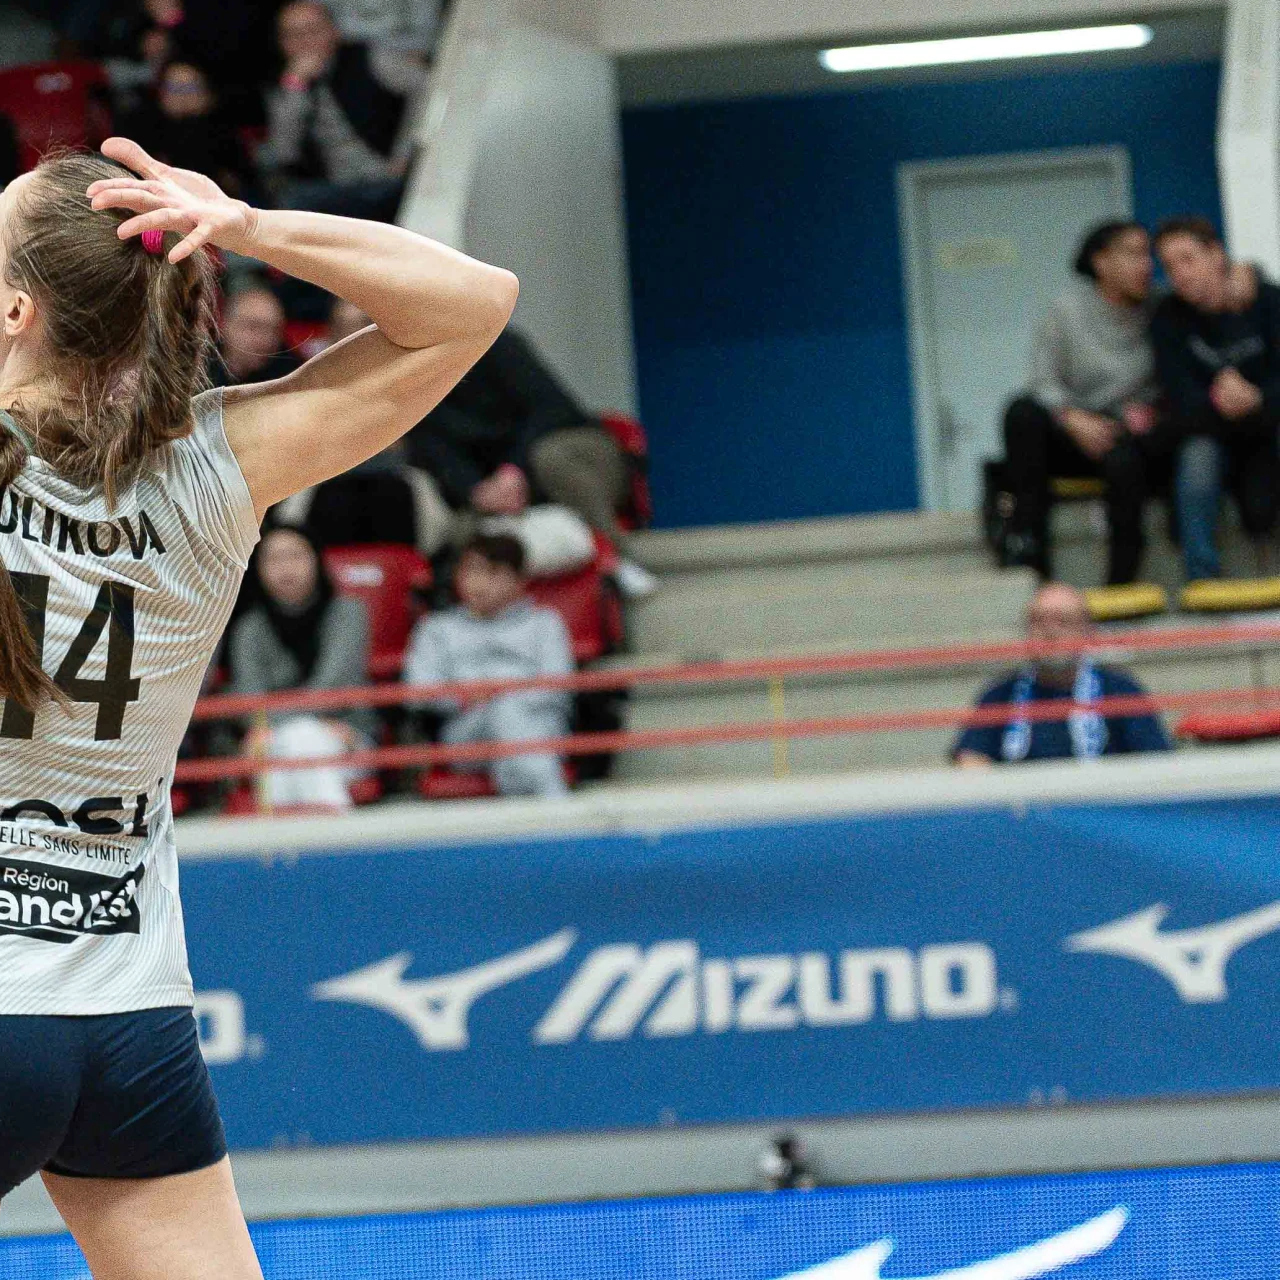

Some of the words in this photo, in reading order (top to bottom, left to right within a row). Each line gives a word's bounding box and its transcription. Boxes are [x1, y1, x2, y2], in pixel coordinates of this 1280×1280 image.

[0, 571, 141, 741] 14
[43, 835, 80, 856] SANS
[86, 842, 132, 865] LIMITE
[3, 867, 69, 894] Région
